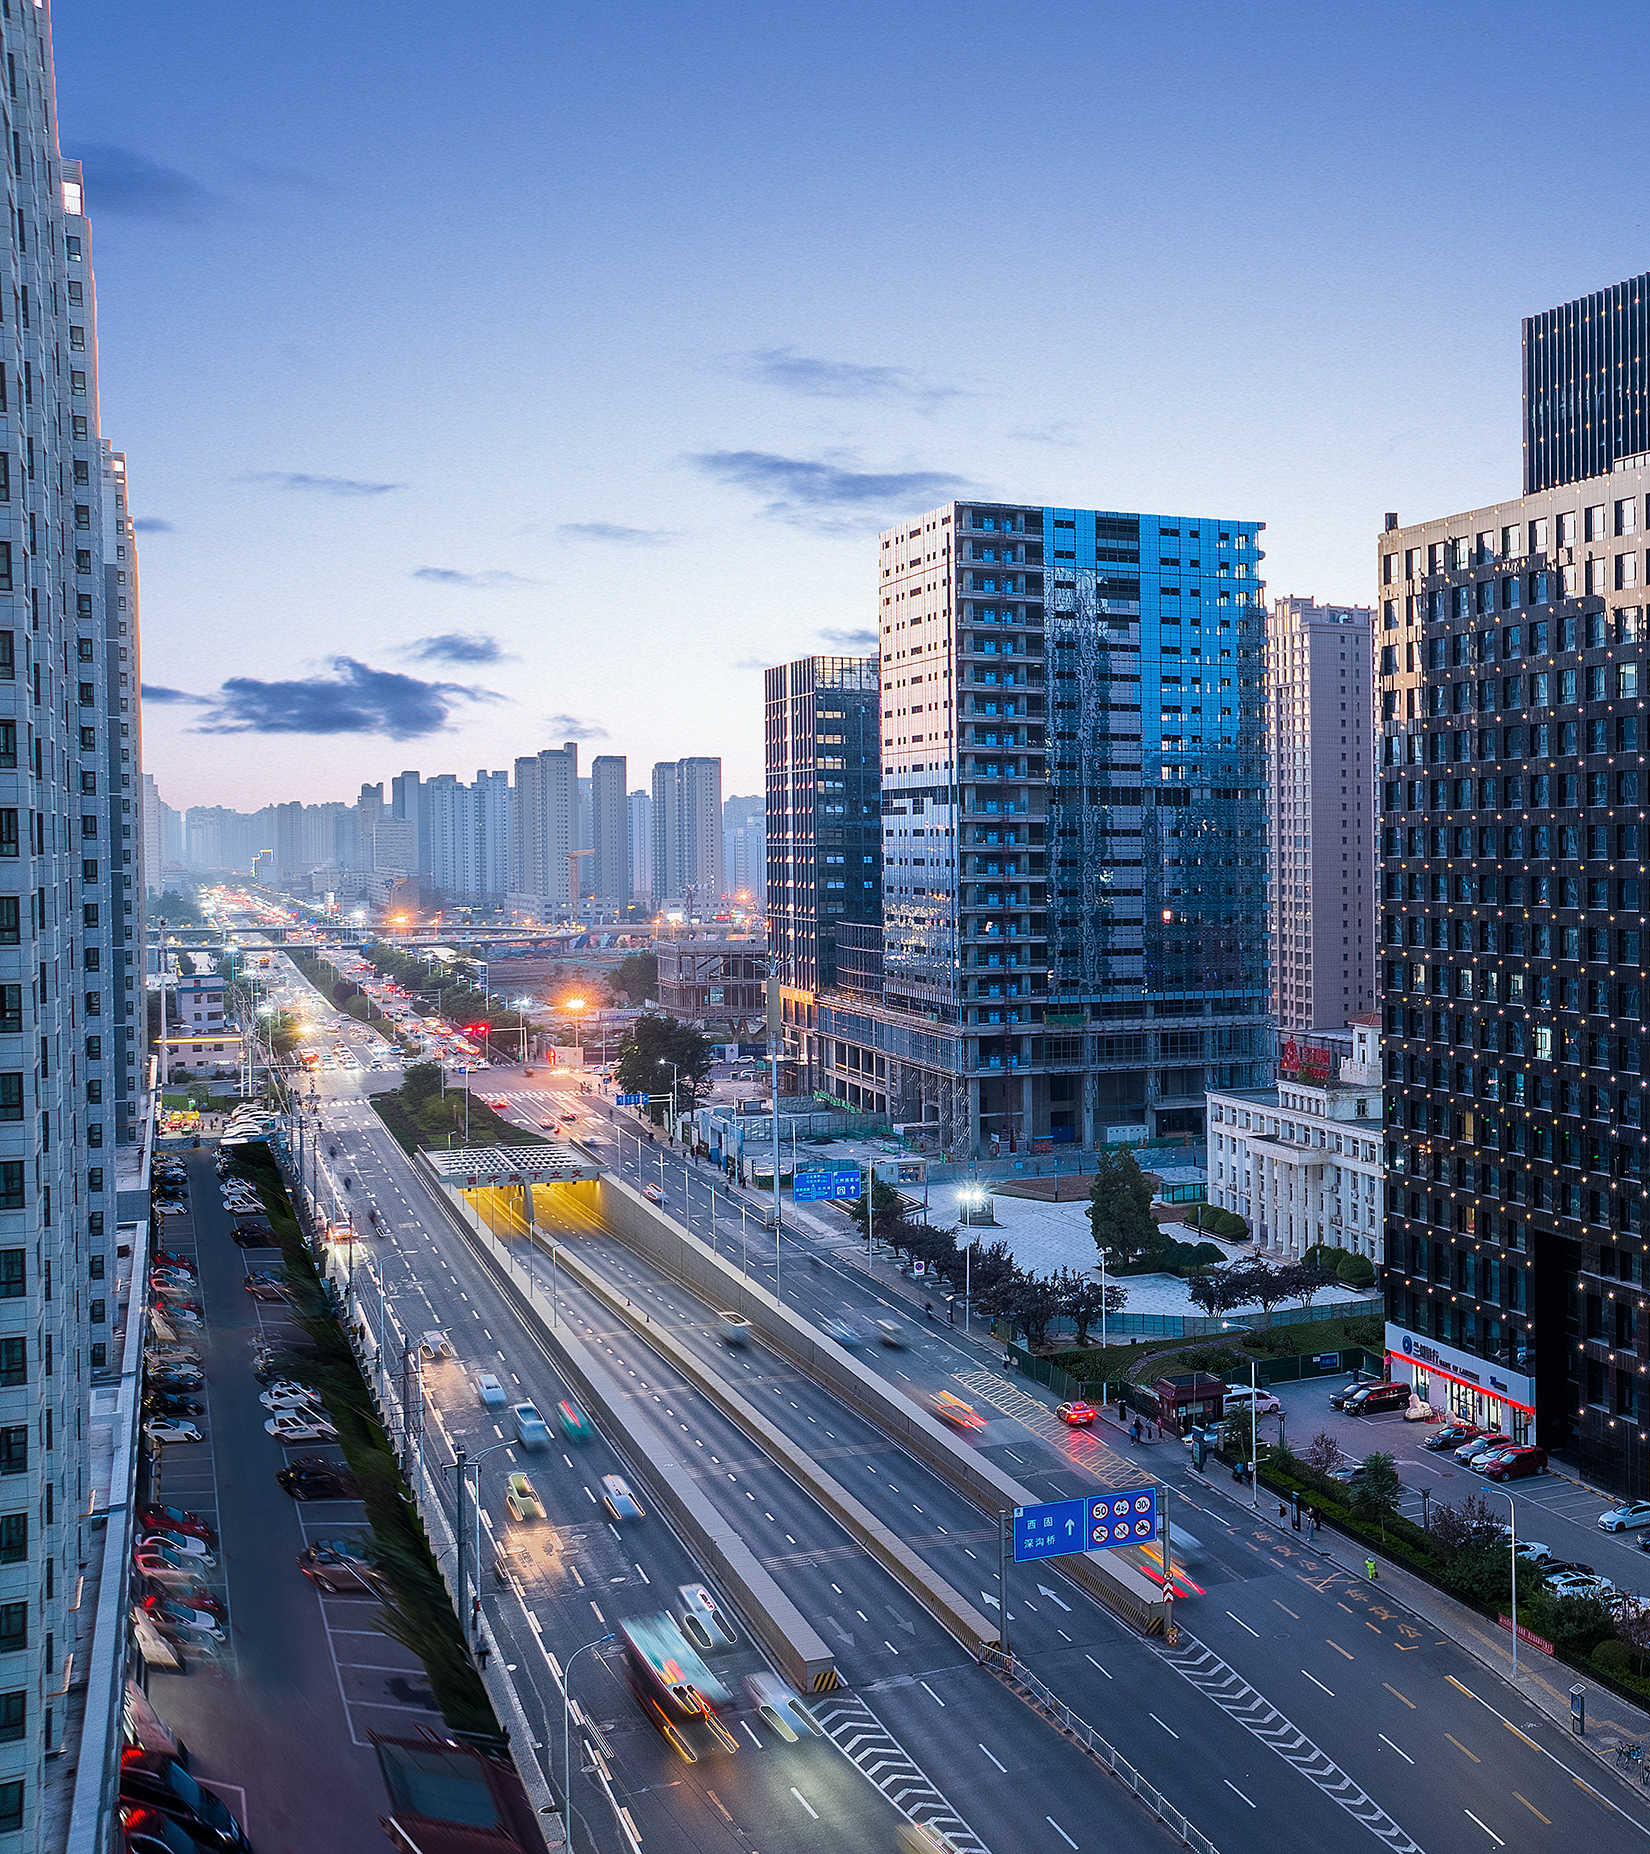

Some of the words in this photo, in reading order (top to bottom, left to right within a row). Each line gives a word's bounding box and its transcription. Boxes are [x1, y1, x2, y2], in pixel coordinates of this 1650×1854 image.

[1095, 1506, 1107, 1516] 50
[1024, 1534, 1056, 1549] 深沟桥
